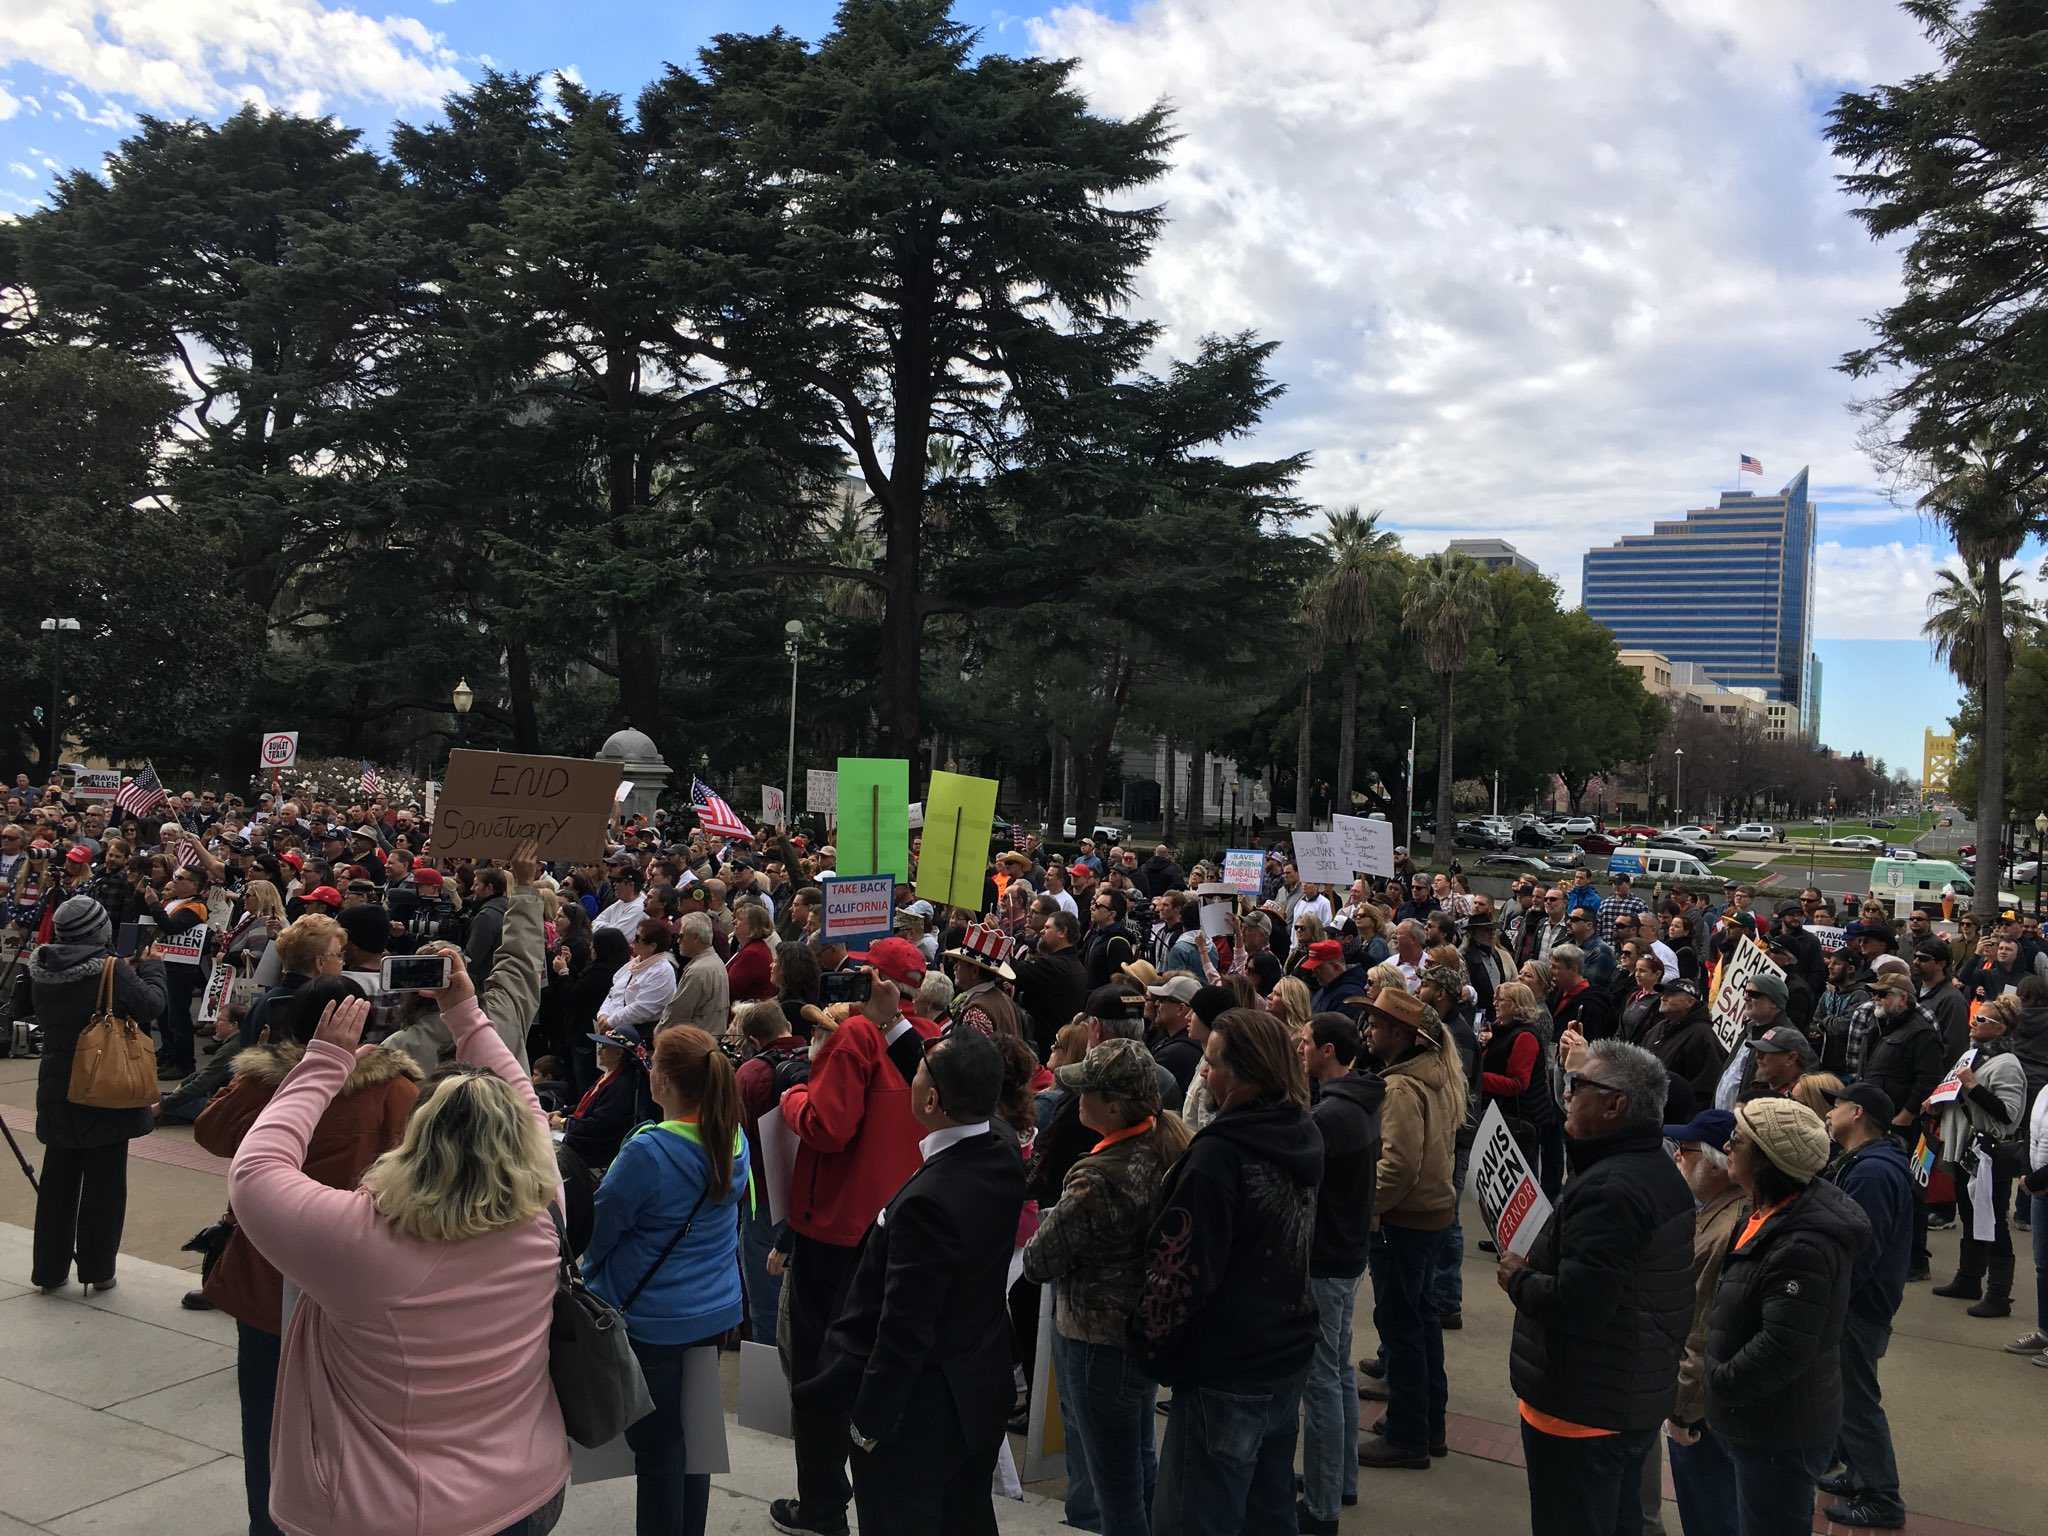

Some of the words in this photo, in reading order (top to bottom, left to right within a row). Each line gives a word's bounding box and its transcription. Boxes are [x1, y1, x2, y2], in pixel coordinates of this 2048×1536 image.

[269, 750, 287, 758] TRAIN
[90, 774, 119, 782] TRAVIS
[490, 765, 569, 798] END
[90, 781, 119, 789] ALLEN
[832, 884, 858, 895] TAKE
[860, 882, 887, 893] BACK
[828, 900, 889, 914] CALIFORNIA
